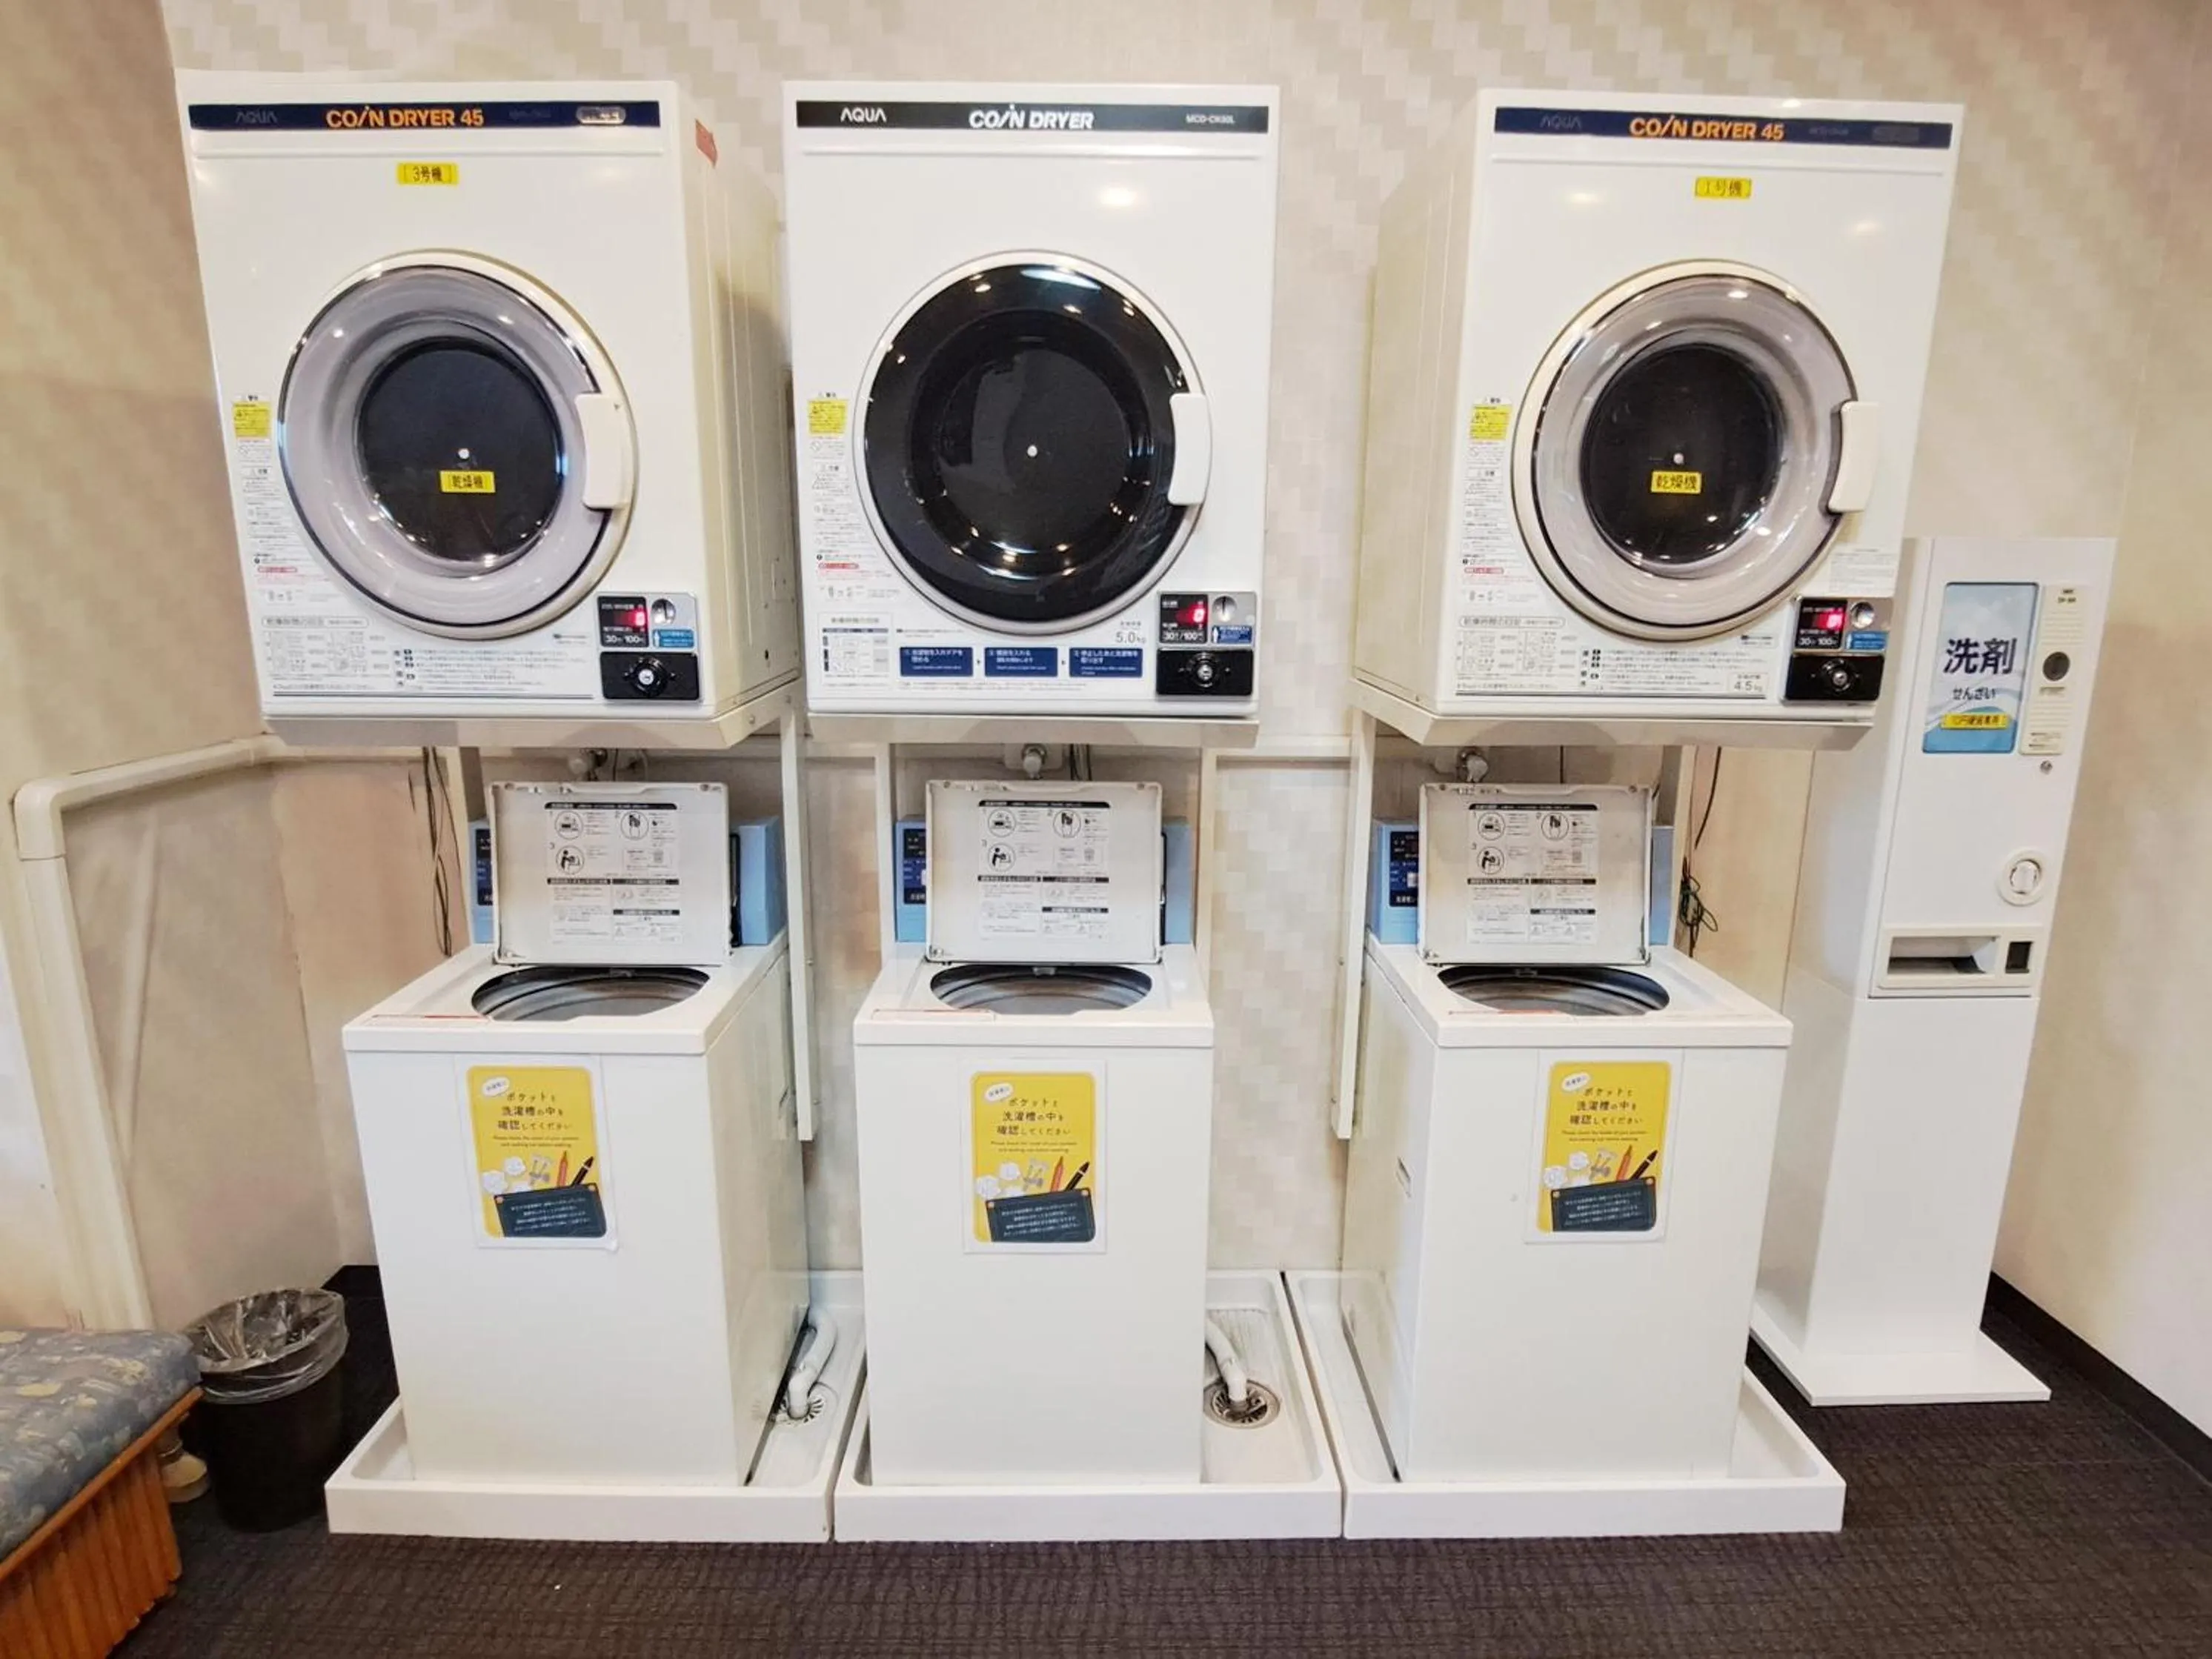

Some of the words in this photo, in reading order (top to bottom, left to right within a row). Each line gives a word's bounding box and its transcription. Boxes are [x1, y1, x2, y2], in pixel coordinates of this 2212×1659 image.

[389, 109, 455, 127] DRYER
[460, 108, 484, 126] 45
[840, 107, 887, 122] AQUA
[1029, 110, 1095, 129] DRYER
[1693, 121, 1756, 139] DRYER
[1761, 123, 1784, 140] 45
[413, 165, 442, 184] 3号機
[1942, 638, 2018, 675] 洗剤
[1953, 687, 1996, 700] せんざい
